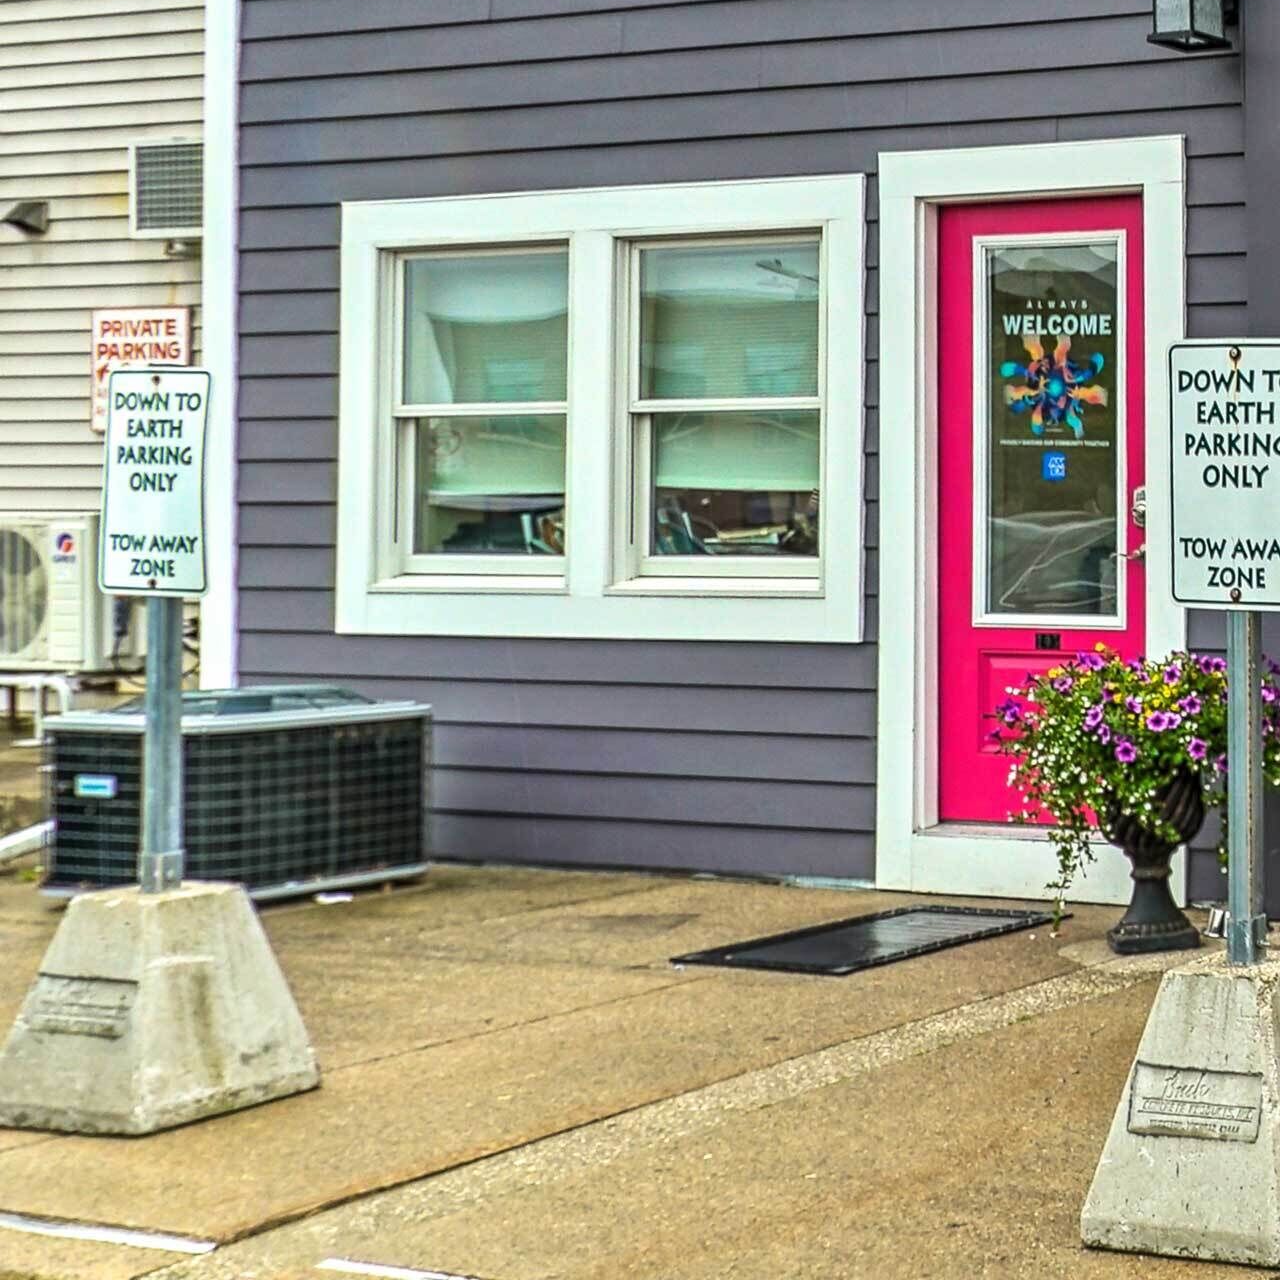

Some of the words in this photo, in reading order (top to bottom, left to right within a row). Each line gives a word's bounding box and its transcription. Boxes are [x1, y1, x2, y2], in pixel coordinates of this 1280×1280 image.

[1026, 300, 1088, 309] ALWAYS
[101, 319, 176, 337] PRIVATE
[1003, 314, 1112, 335] WELCOME
[98, 341, 180, 360] PARKING
[1178, 369, 1254, 393] DOWN
[116, 392, 169, 411] DOWN
[175, 393, 201, 411] TO
[1197, 401, 1274, 425] EARTH
[128, 419, 183, 438] EARTH
[118, 446, 192, 465] PARKING
[130, 472, 177, 492] ONLY
[1203, 465, 1269, 488] ONLY
[110, 534, 146, 551] TOW
[150, 536, 198, 553] AWAY
[1179, 537, 1226, 559] TOW
[130, 559, 175, 577] ZONE
[1208, 566, 1265, 588] ZONE
